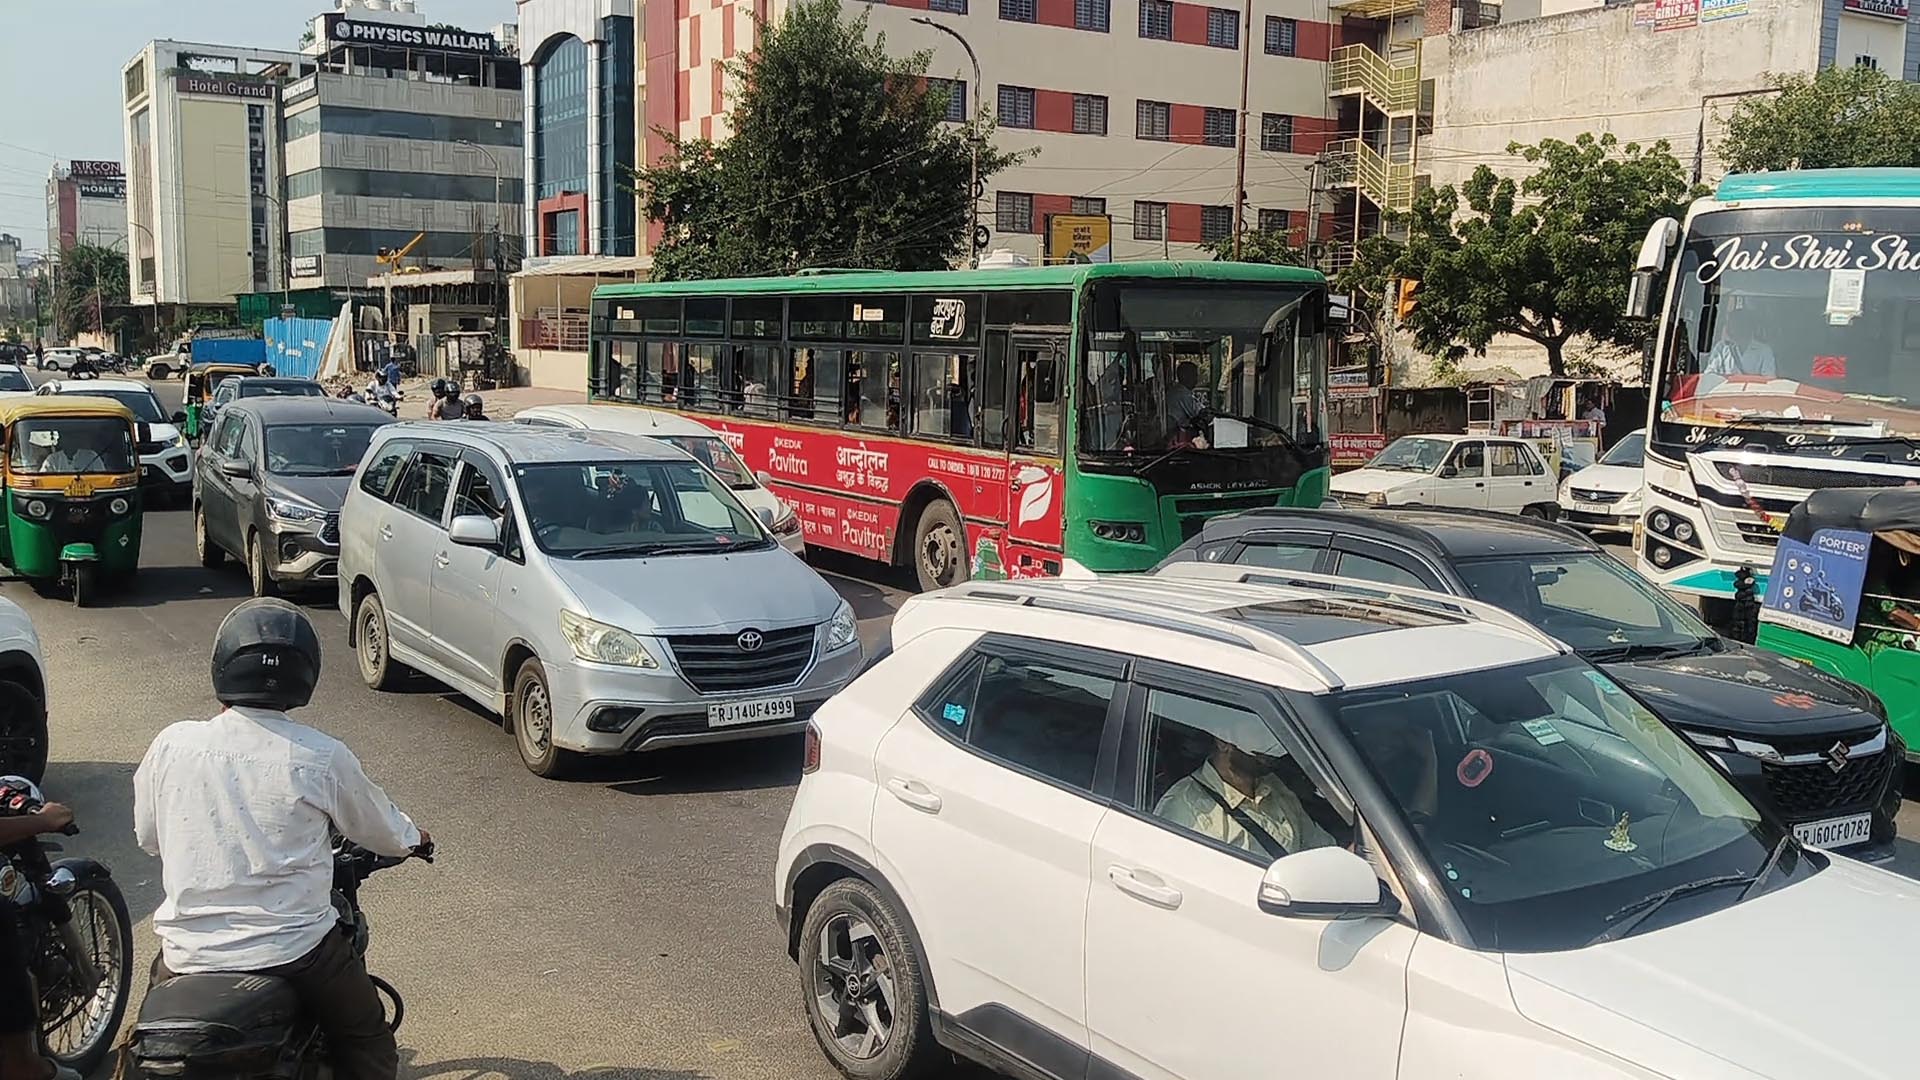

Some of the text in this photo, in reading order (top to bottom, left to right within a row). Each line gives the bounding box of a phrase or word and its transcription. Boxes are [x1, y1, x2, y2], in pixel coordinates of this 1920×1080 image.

[1656, 5, 1681, 19] GIRLS
[353, 25, 422, 43] PHYSICS
[424, 32, 490, 50] WALLAH
[189, 79, 223, 93] Hotel
[227, 82, 267, 96] Grand
[82, 185, 115, 193] HOME
[1696, 236, 1769, 284] Jai
[1770, 234, 1853, 270] Shri
[930, 317, 945, 334] बस
[778, 437, 802, 449] KEDIA
[769, 449, 808, 475] Pavitra
[836, 441, 889, 471] आन्दोलन
[928, 457, 939, 469] CALL
[852, 510, 879, 524] KEDIA
[841, 520, 886, 551] Pavitra
[1819, 535, 1860, 553] PORTER
[718, 700, 792, 722] RJ14UF4999
[1803, 818, 1870, 846] RJ60CF0782
